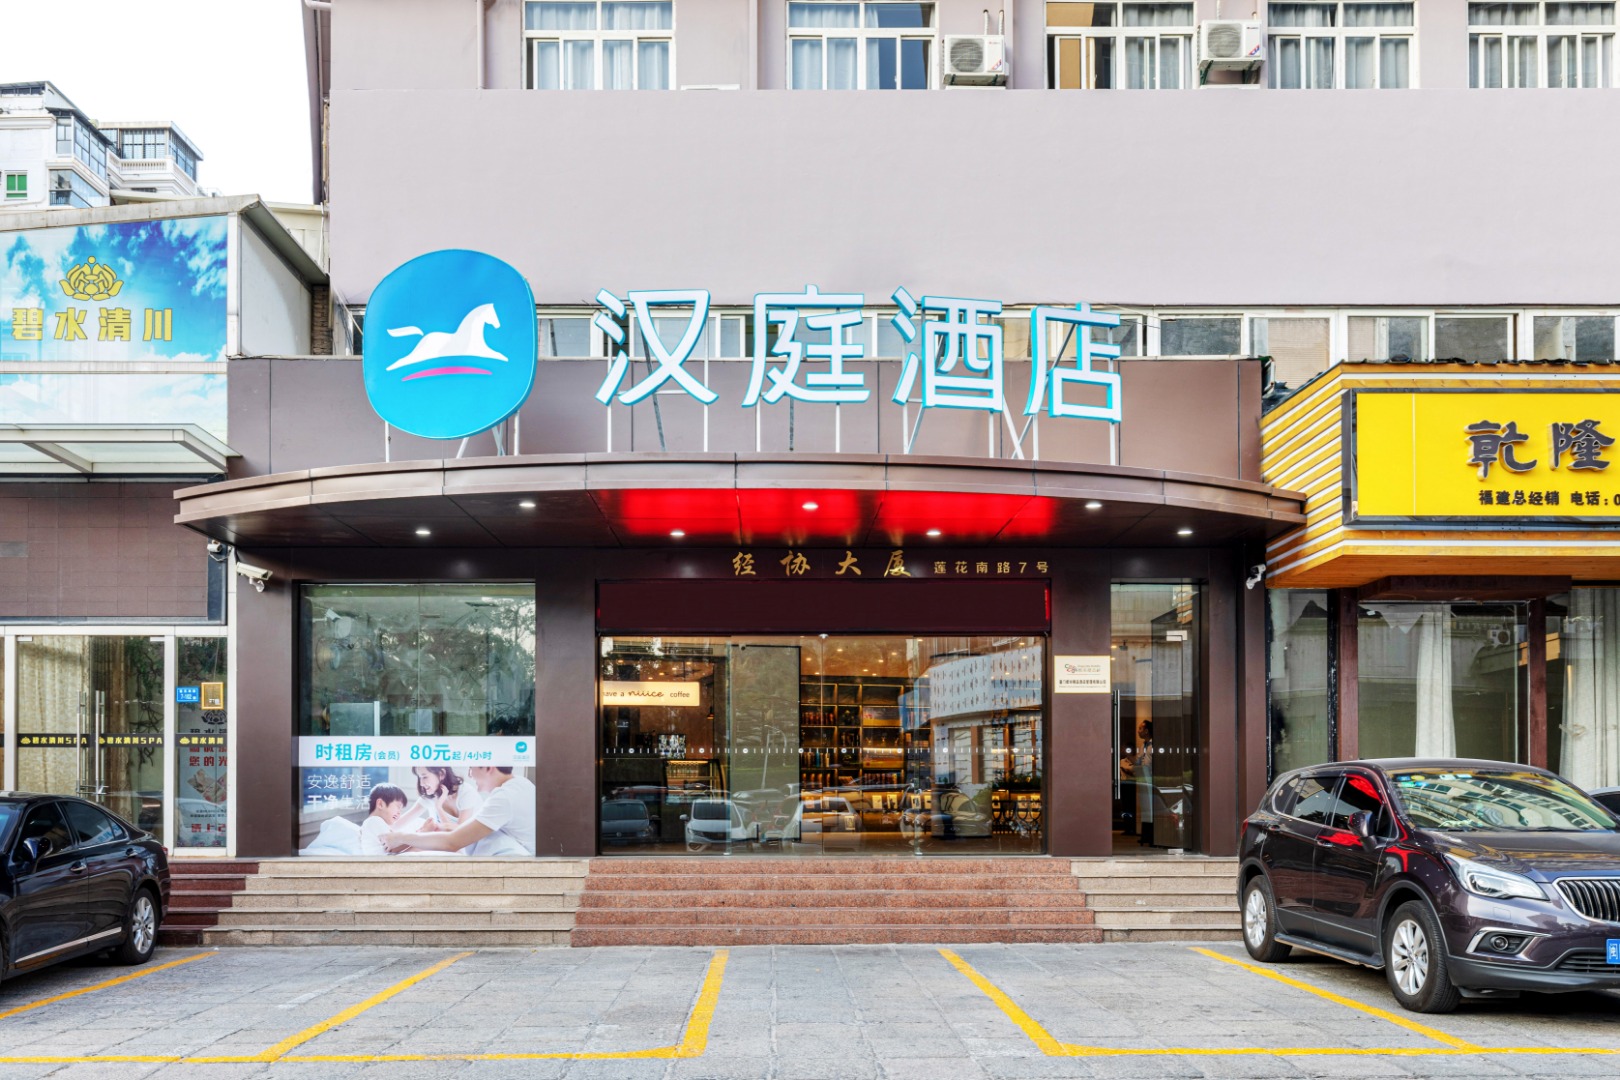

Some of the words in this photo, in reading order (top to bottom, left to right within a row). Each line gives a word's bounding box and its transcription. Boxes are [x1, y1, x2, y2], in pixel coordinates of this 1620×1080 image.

[11, 307, 172, 341] 碧水清川
[594, 284, 1122, 423] 汉庭酒店
[1464, 419, 1616, 481] 乾隆
[1479, 490, 1560, 505] 福建总经销
[732, 550, 911, 577] 经协大厦
[934, 561, 1049, 574] 莲花南路7号
[307, 774, 372, 790] 安逸舒适
